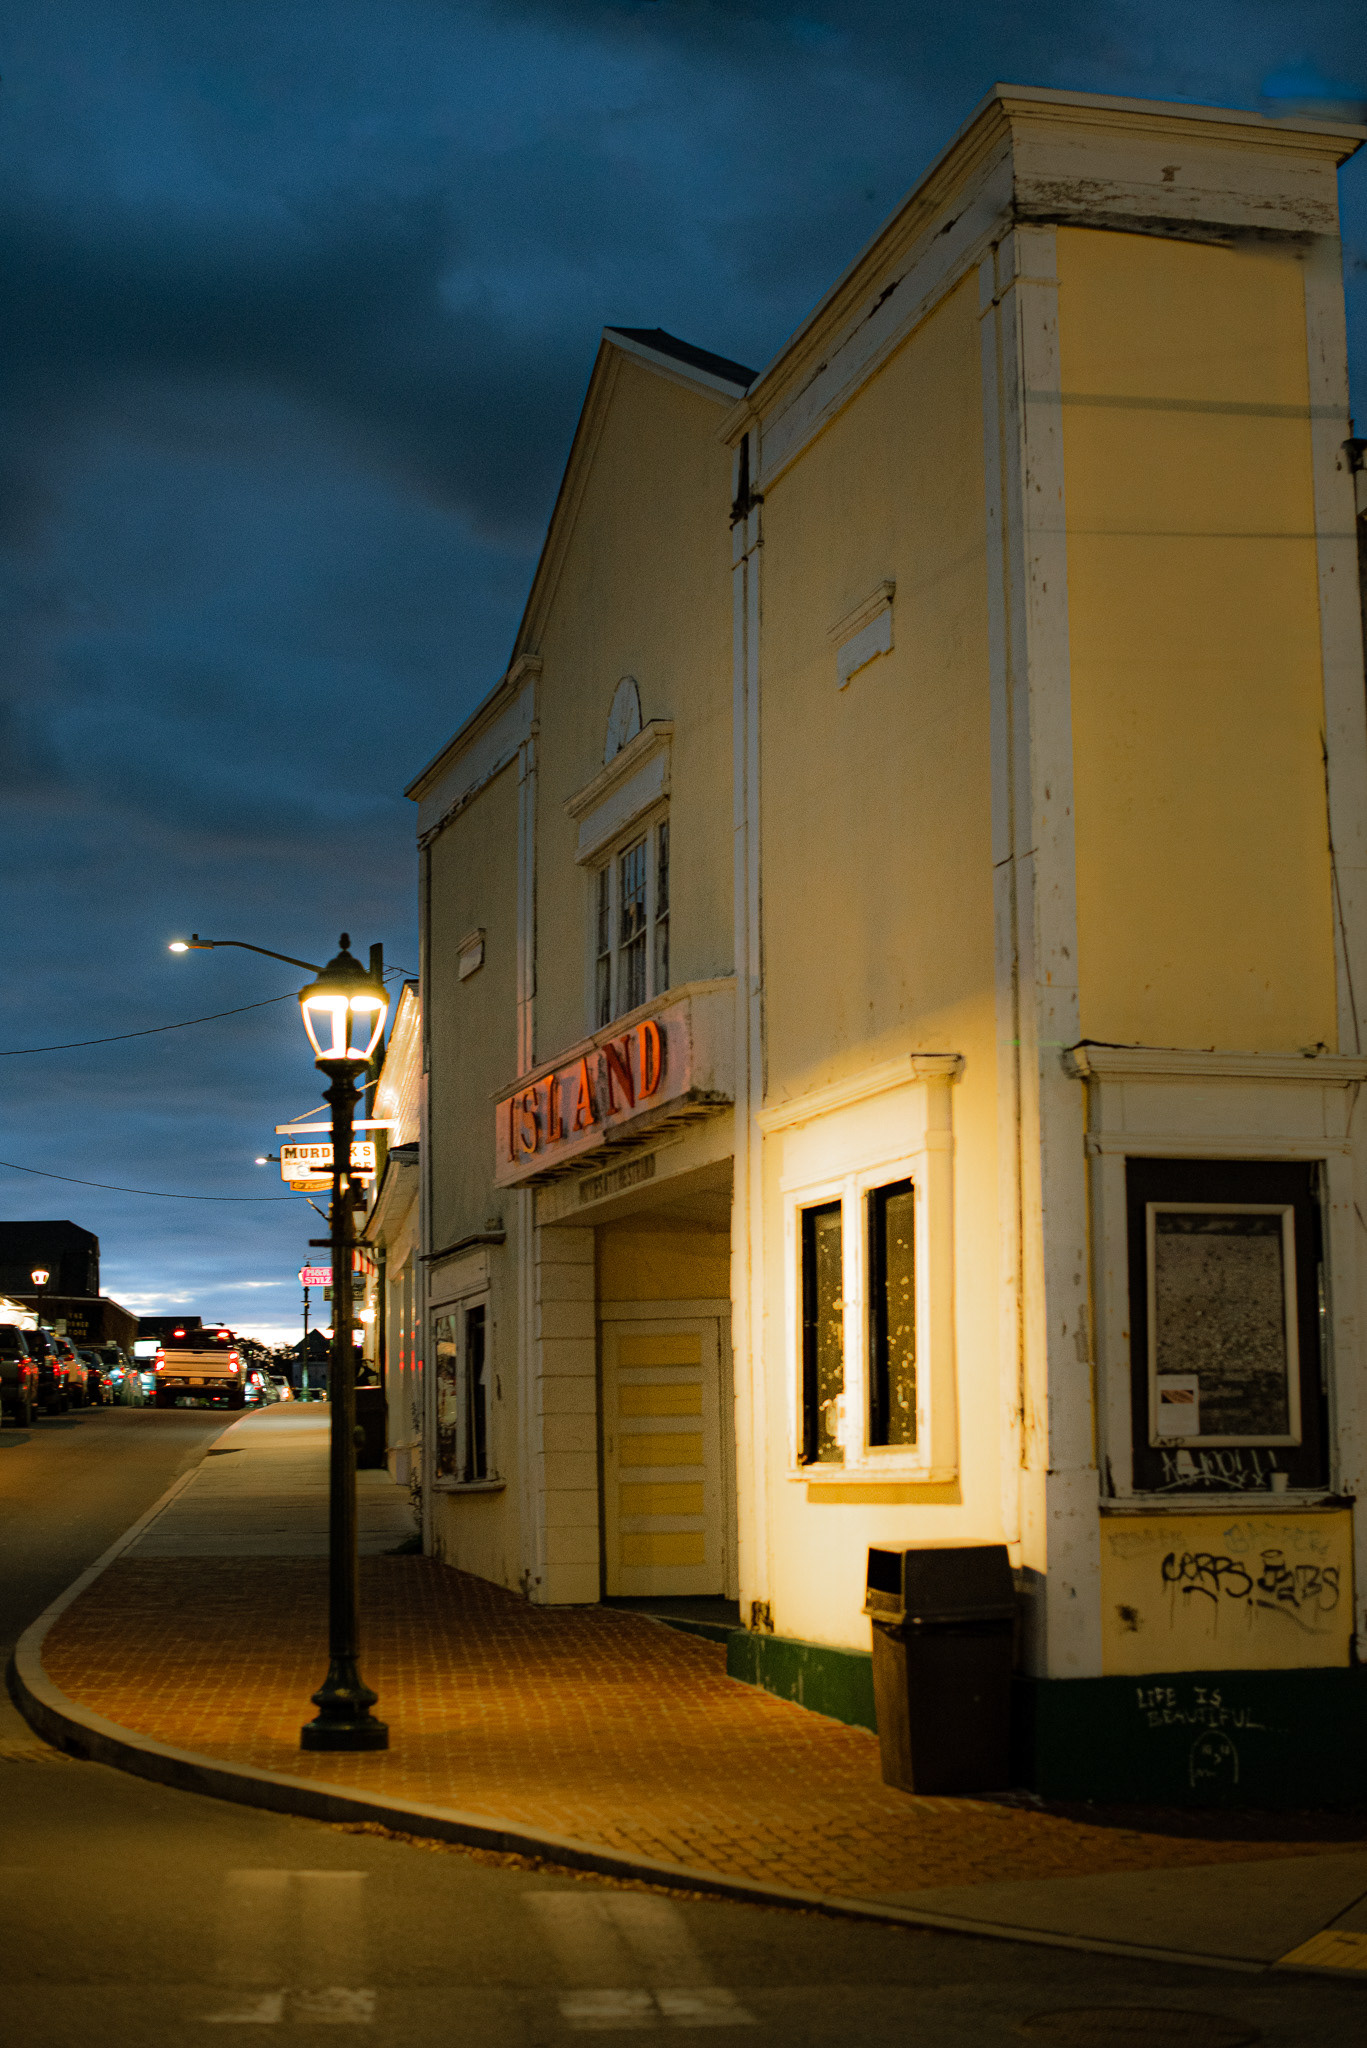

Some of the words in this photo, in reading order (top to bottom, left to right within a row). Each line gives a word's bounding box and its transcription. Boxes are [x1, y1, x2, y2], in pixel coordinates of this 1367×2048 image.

[507, 1020, 662, 1162] ISLAND
[306, 1276, 331, 1284] STYLZ
[1136, 1686, 1176, 1708] LIFE
[1193, 1686, 1223, 1708] IS
